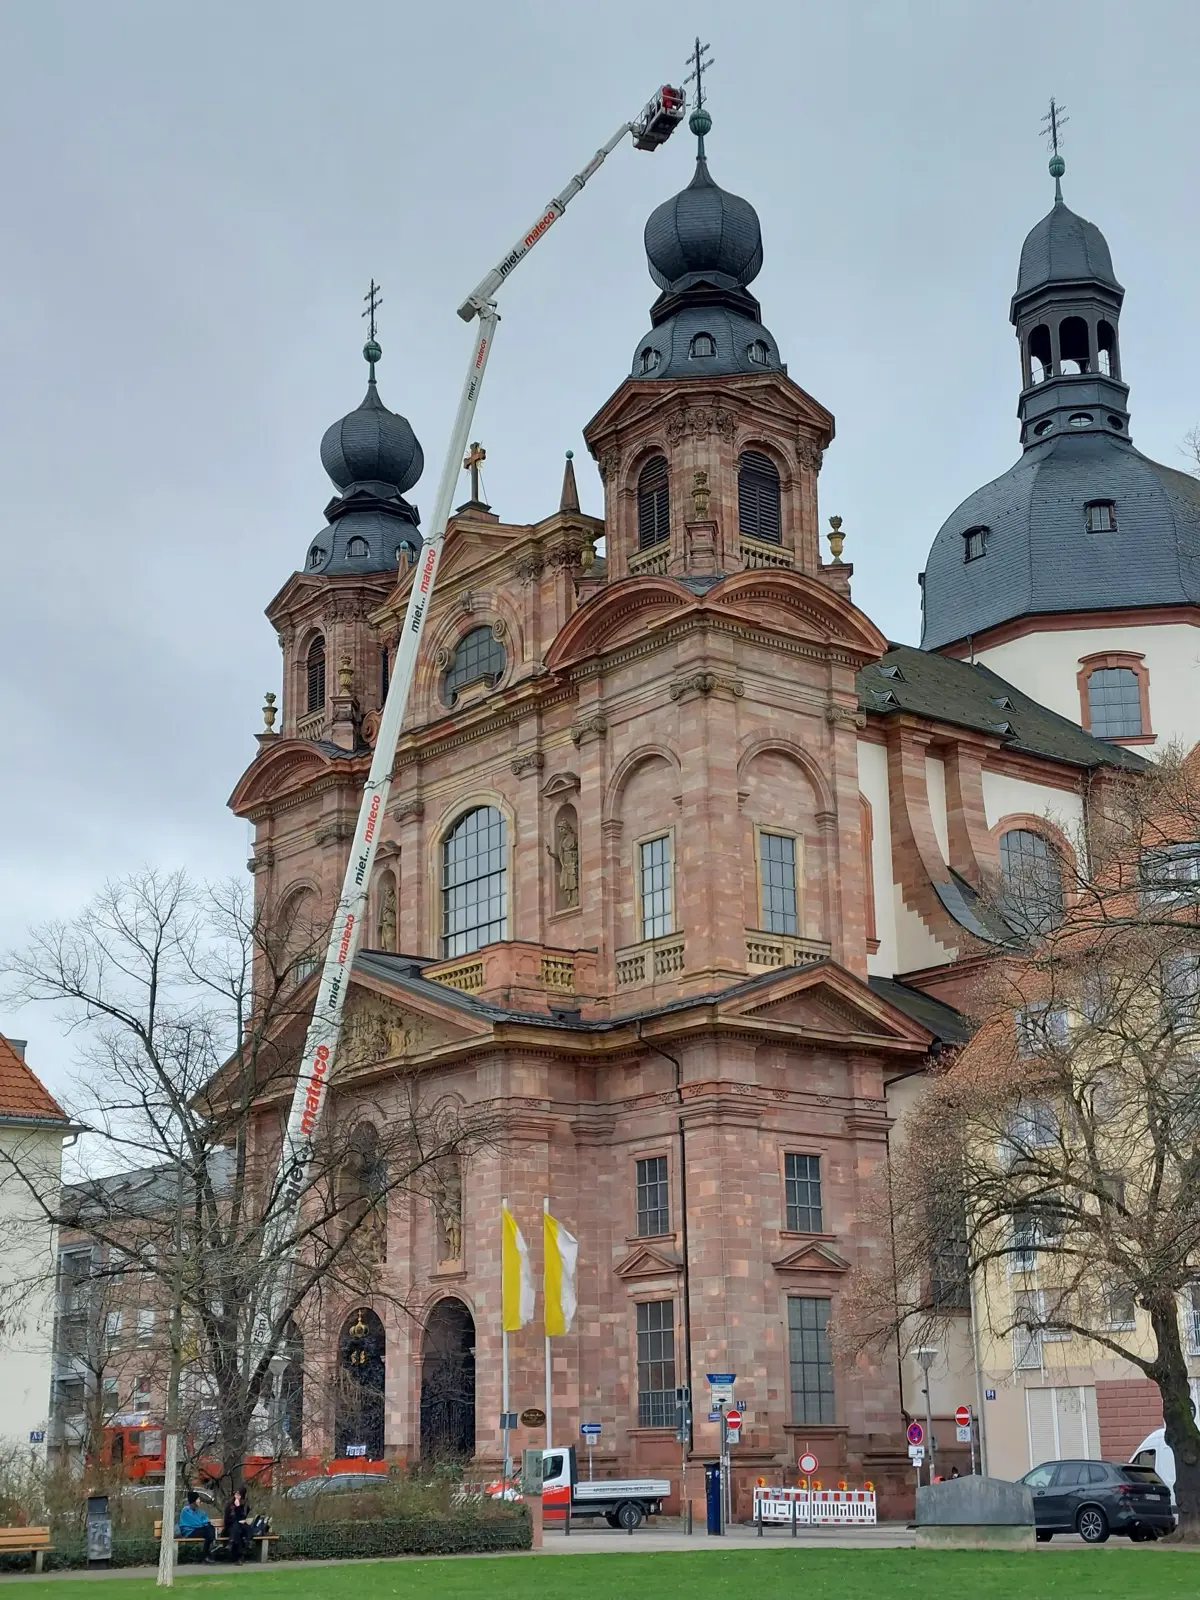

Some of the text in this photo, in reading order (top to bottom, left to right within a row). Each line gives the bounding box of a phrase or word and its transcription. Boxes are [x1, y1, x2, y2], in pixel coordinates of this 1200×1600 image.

[500, 210, 555, 276] miet... mateco
[475, 338, 487, 369] mateco
[411, 549, 436, 634] miet... mateco
[355, 795, 381, 887] miet... mateco
[328, 914, 355, 1009] miet... mateco
[300, 1044, 330, 1136] mateco
